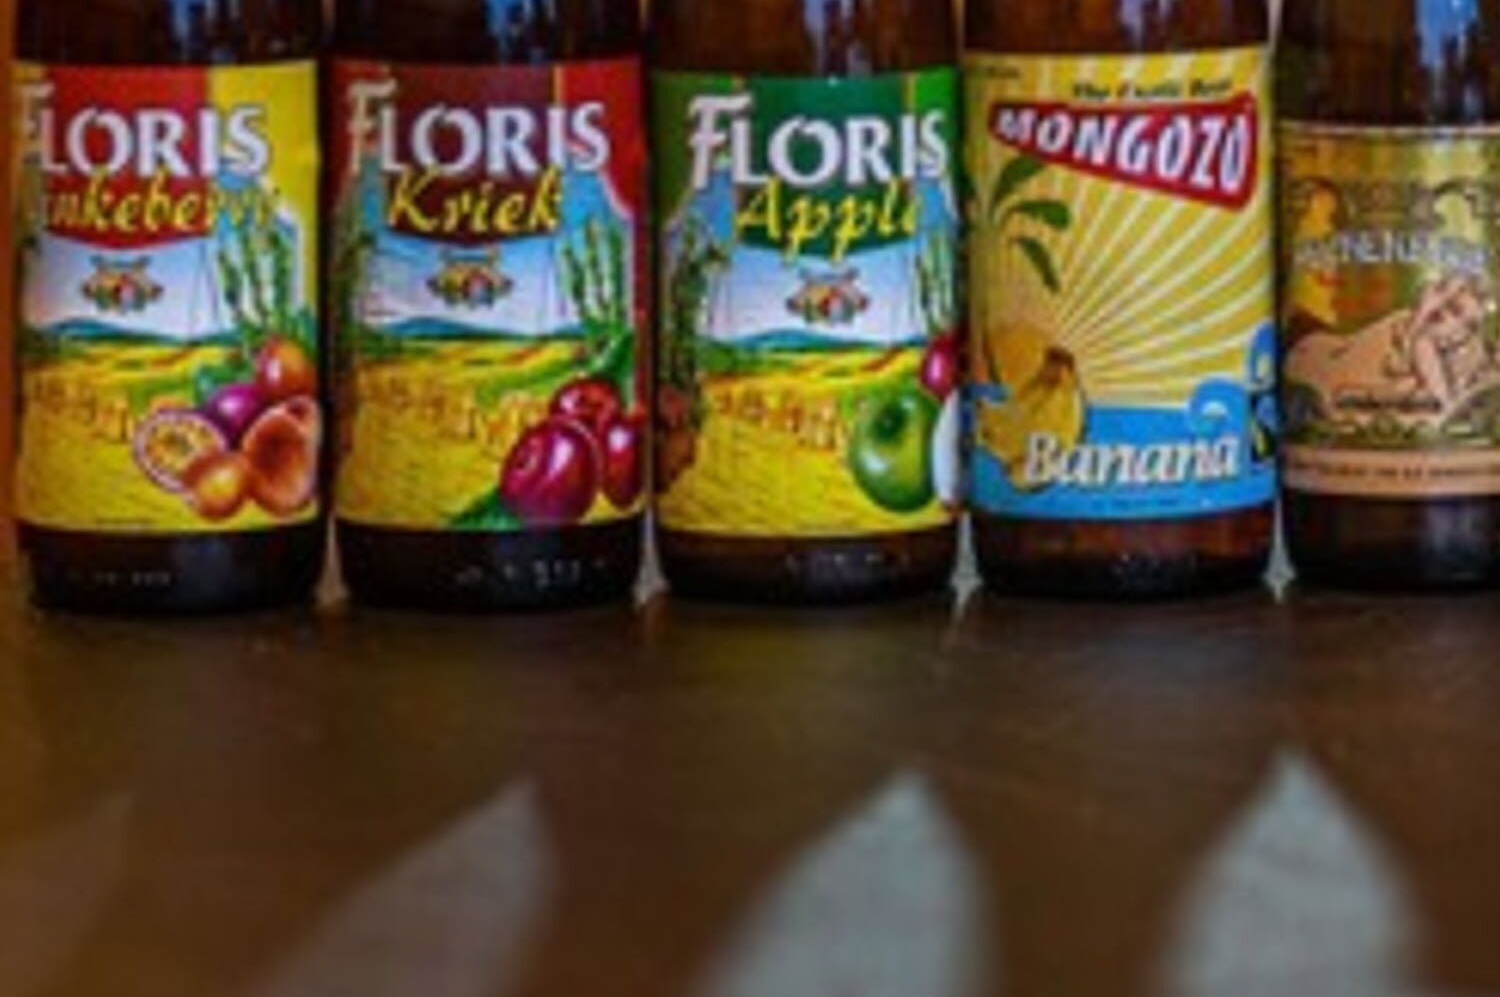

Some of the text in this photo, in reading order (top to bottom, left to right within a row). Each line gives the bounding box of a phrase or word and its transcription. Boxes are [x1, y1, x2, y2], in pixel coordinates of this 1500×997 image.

[346, 78, 610, 179] FLORIS
[688, 93, 950, 190] FLORIS
[996, 108, 1249, 195] MONGOZO
[386, 162, 563, 235] Kriek
[735, 176, 920, 264] Apple
[1022, 431, 1241, 486] Banana
